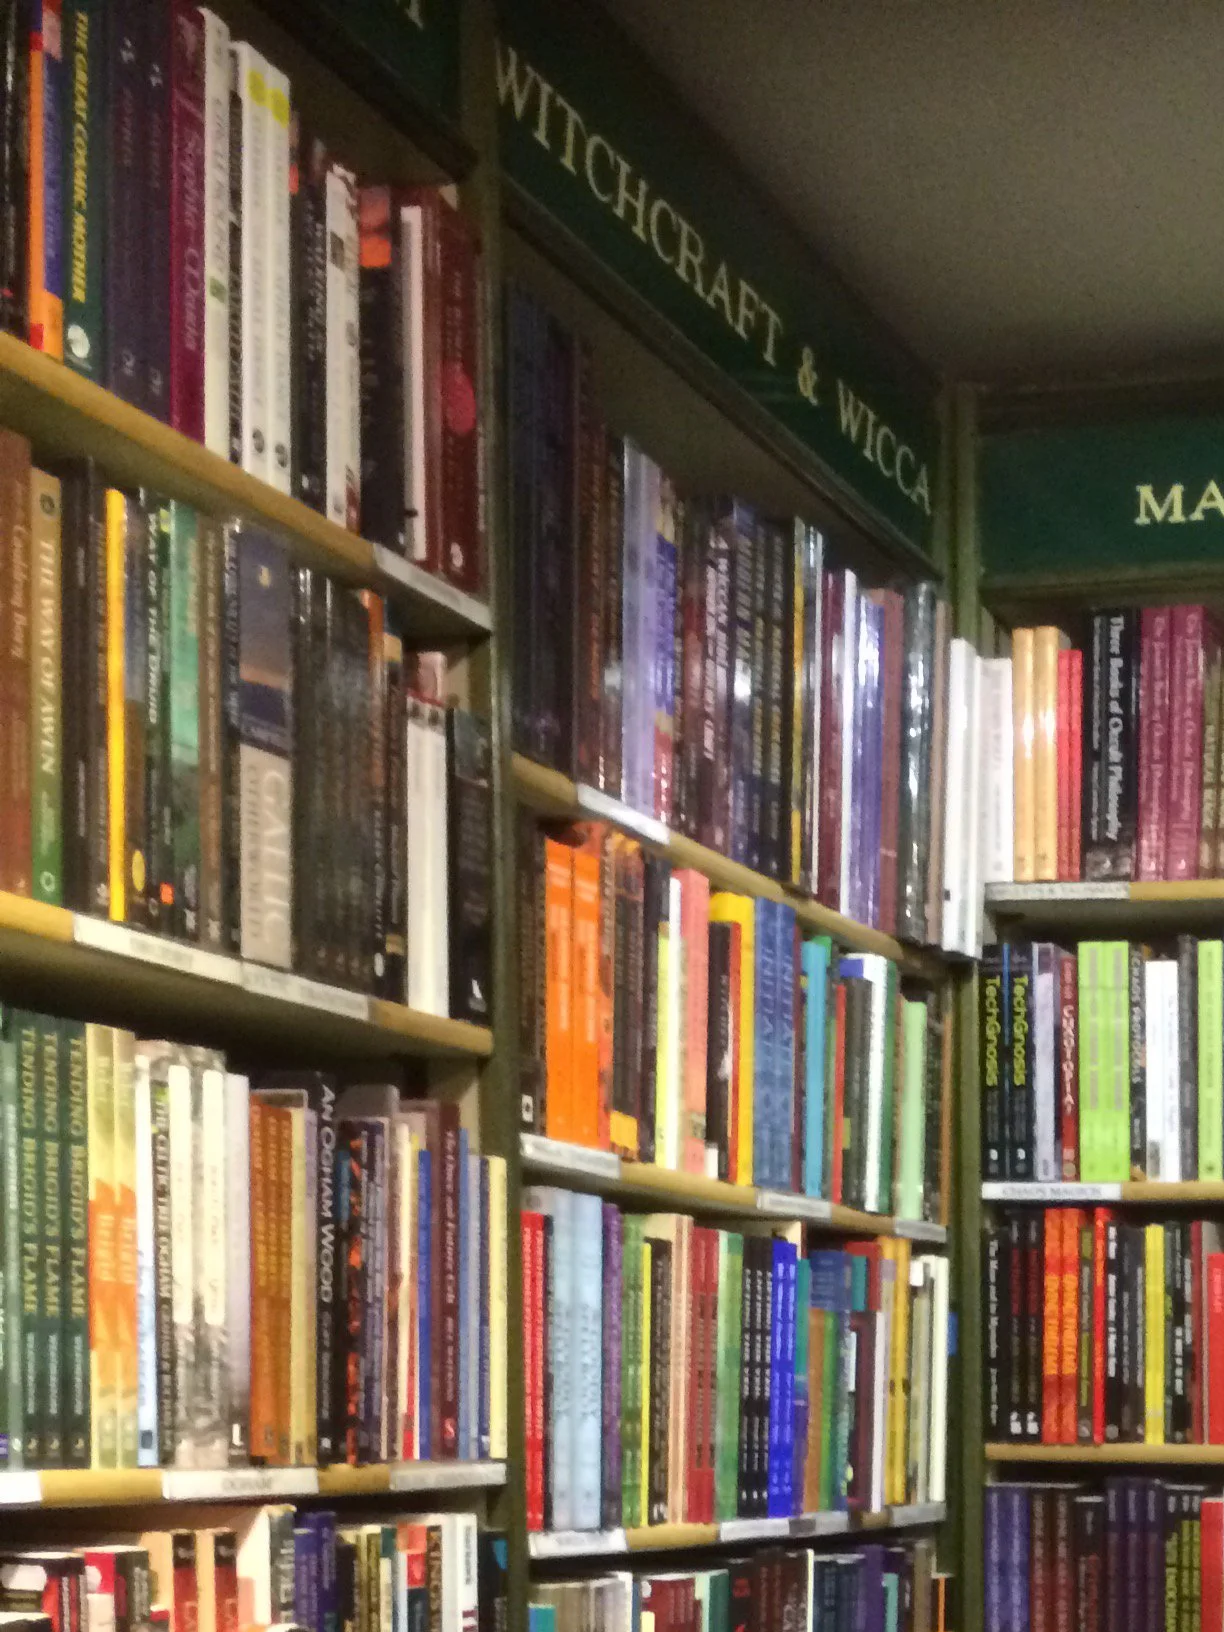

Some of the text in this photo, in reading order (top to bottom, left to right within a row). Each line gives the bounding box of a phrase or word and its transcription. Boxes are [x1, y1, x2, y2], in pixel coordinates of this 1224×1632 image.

[496, 44, 783, 368] WITCHCRAFT
[836, 378, 933, 517] WICCA
[985, 975, 1001, 1086] TechGnosis
[1012, 975, 1029, 1086] TechGnosis
[21, 1027, 38, 1129] TENDING
[44, 1033, 60, 1133] TENDING
[69, 1037, 85, 1136] TENDING
[321, 1084, 335, 1121] AN
[320, 1127, 335, 1217] OGHAM
[21, 1242, 38, 1315] FLAME
[44, 1245, 60, 1317] FLAME
[69, 1247, 85, 1318] FLAME
[321, 1224, 335, 1303] WOOD
